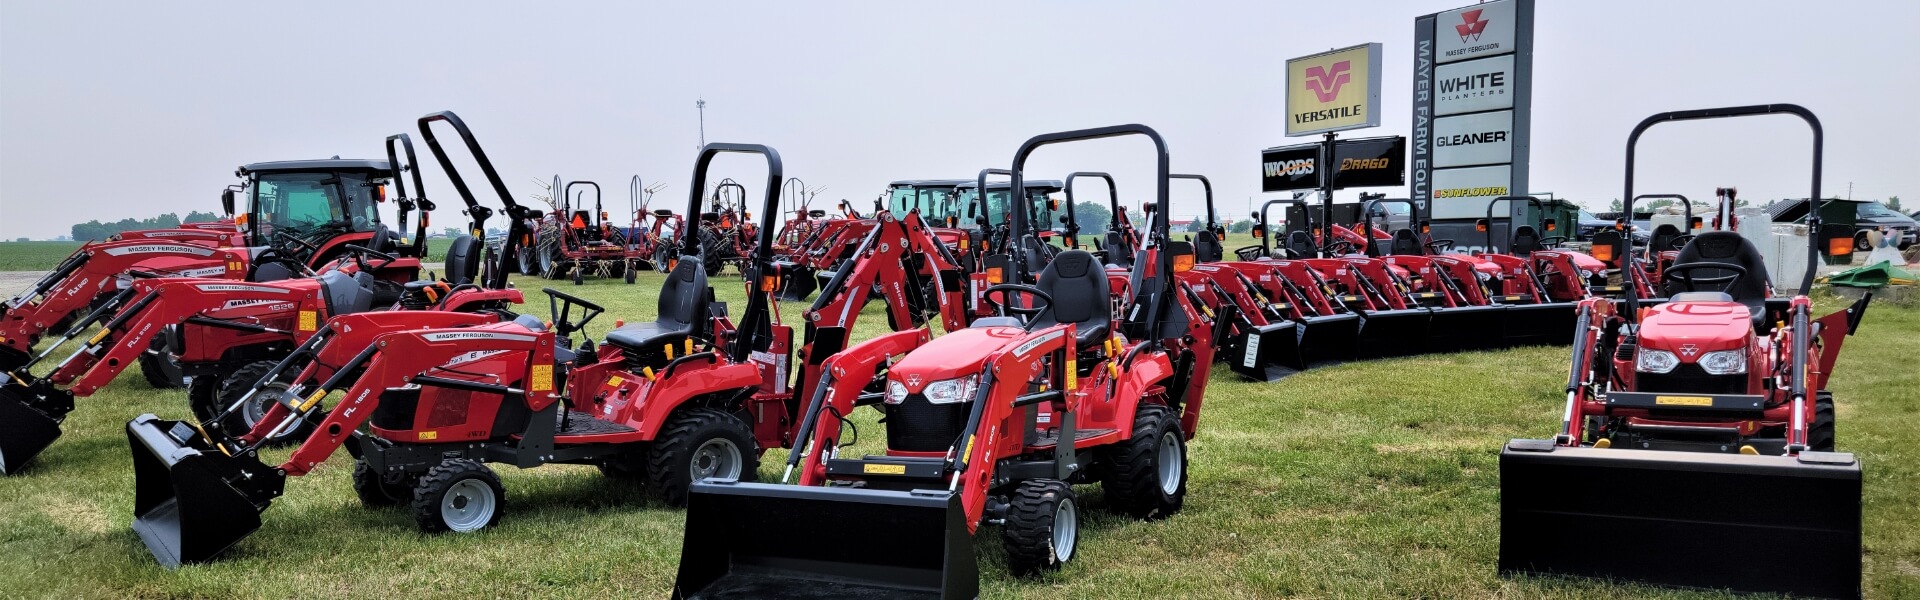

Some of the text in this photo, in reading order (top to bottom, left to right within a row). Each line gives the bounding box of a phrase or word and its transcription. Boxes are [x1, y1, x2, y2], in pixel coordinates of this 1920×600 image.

[1445, 42, 1500, 57] MASSEY FERGUSON
[1439, 71, 1505, 94] WHITE
[1441, 88, 1504, 101] PLANTERS
[1294, 104, 1362, 124] VERSATILE
[1414, 39, 1431, 210] MAYER FARM EQUIP
[1436, 131, 1506, 148] GLEANER
[1263, 158, 1315, 178] WOODS
[1339, 157, 1390, 171] DRAGO
[1441, 186, 1508, 199] SUNFLOWER
[230, 299, 259, 307] MASSEY
[268, 303, 295, 311] 1526
[343, 406, 357, 418] FL
